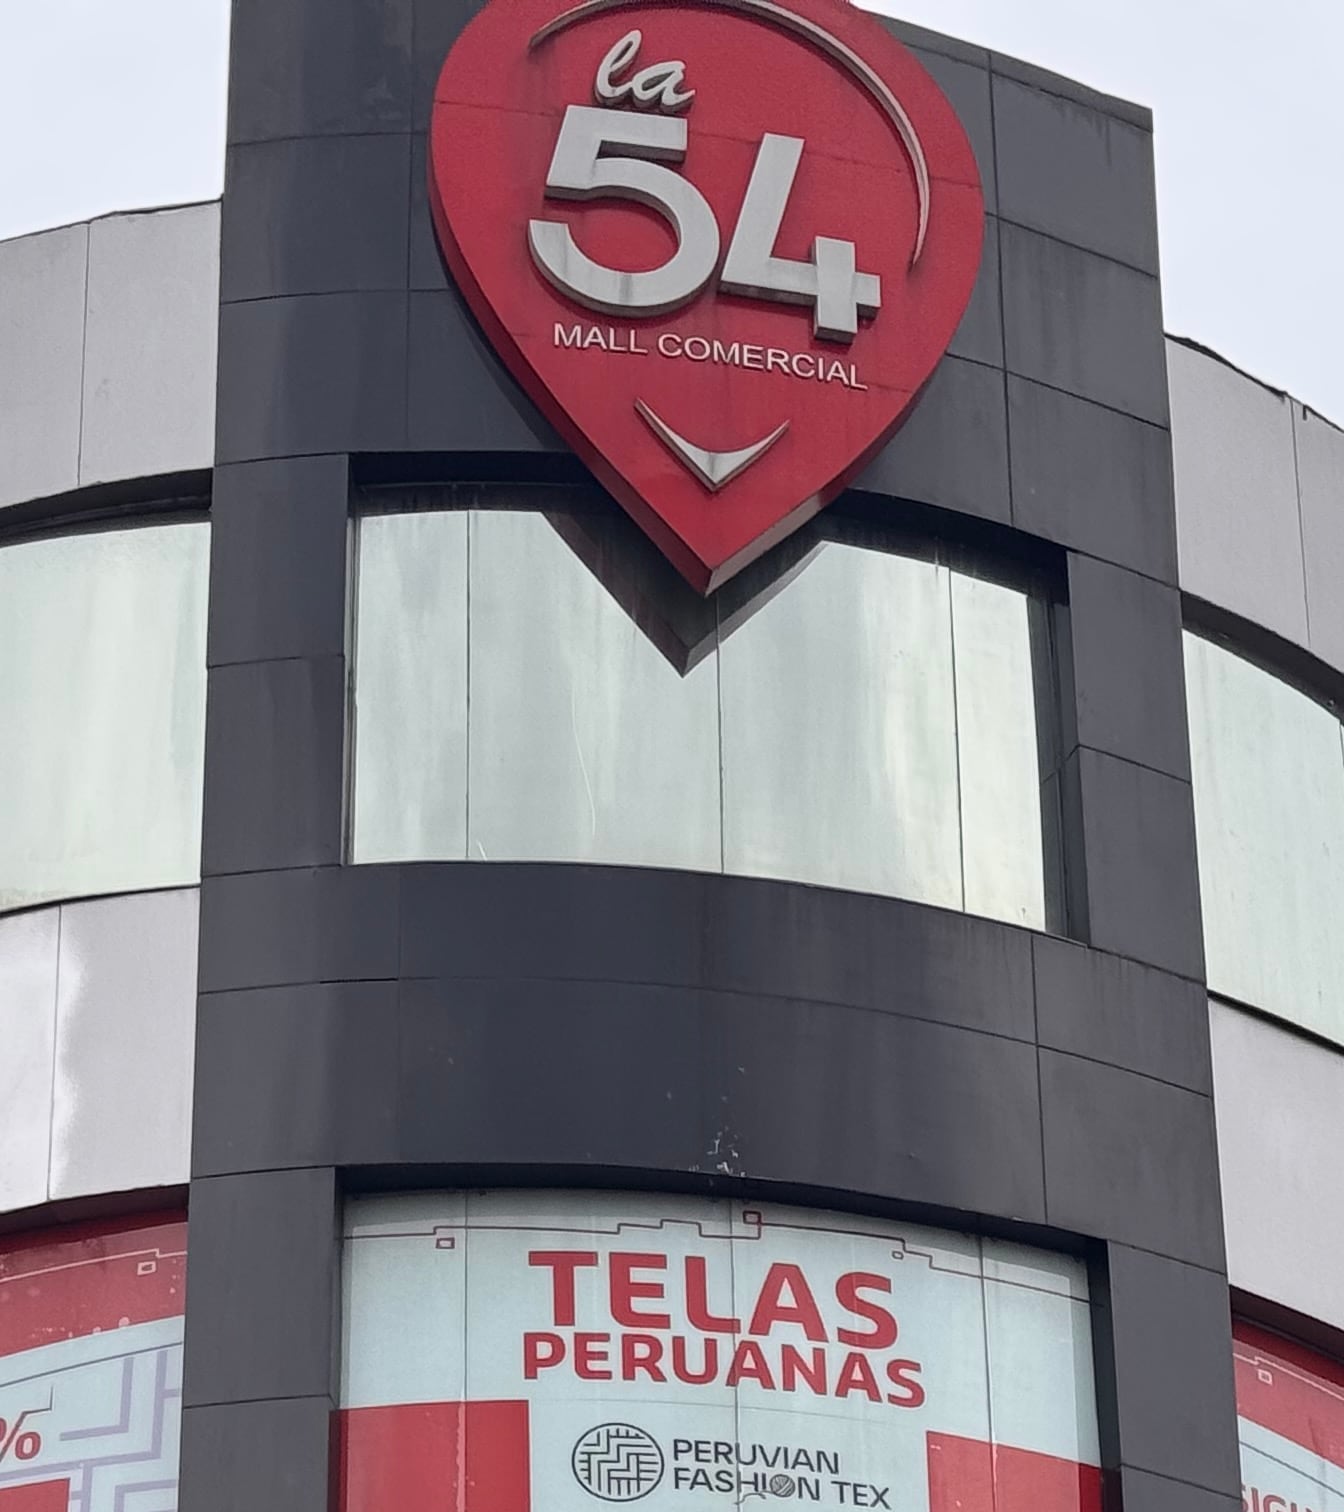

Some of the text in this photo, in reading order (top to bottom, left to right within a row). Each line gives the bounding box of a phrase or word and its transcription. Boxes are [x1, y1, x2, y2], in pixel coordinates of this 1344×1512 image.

[596, 29, 696, 107] la
[528, 104, 881, 344] 54
[554, 322, 868, 390] MALL COMERCIAL
[527, 1250, 899, 1351] TELAS
[522, 1331, 927, 1409] PERUANAS
[672, 1438, 840, 1476] PERUVIAN
[673, 1467, 893, 1511] FASHION TEX
